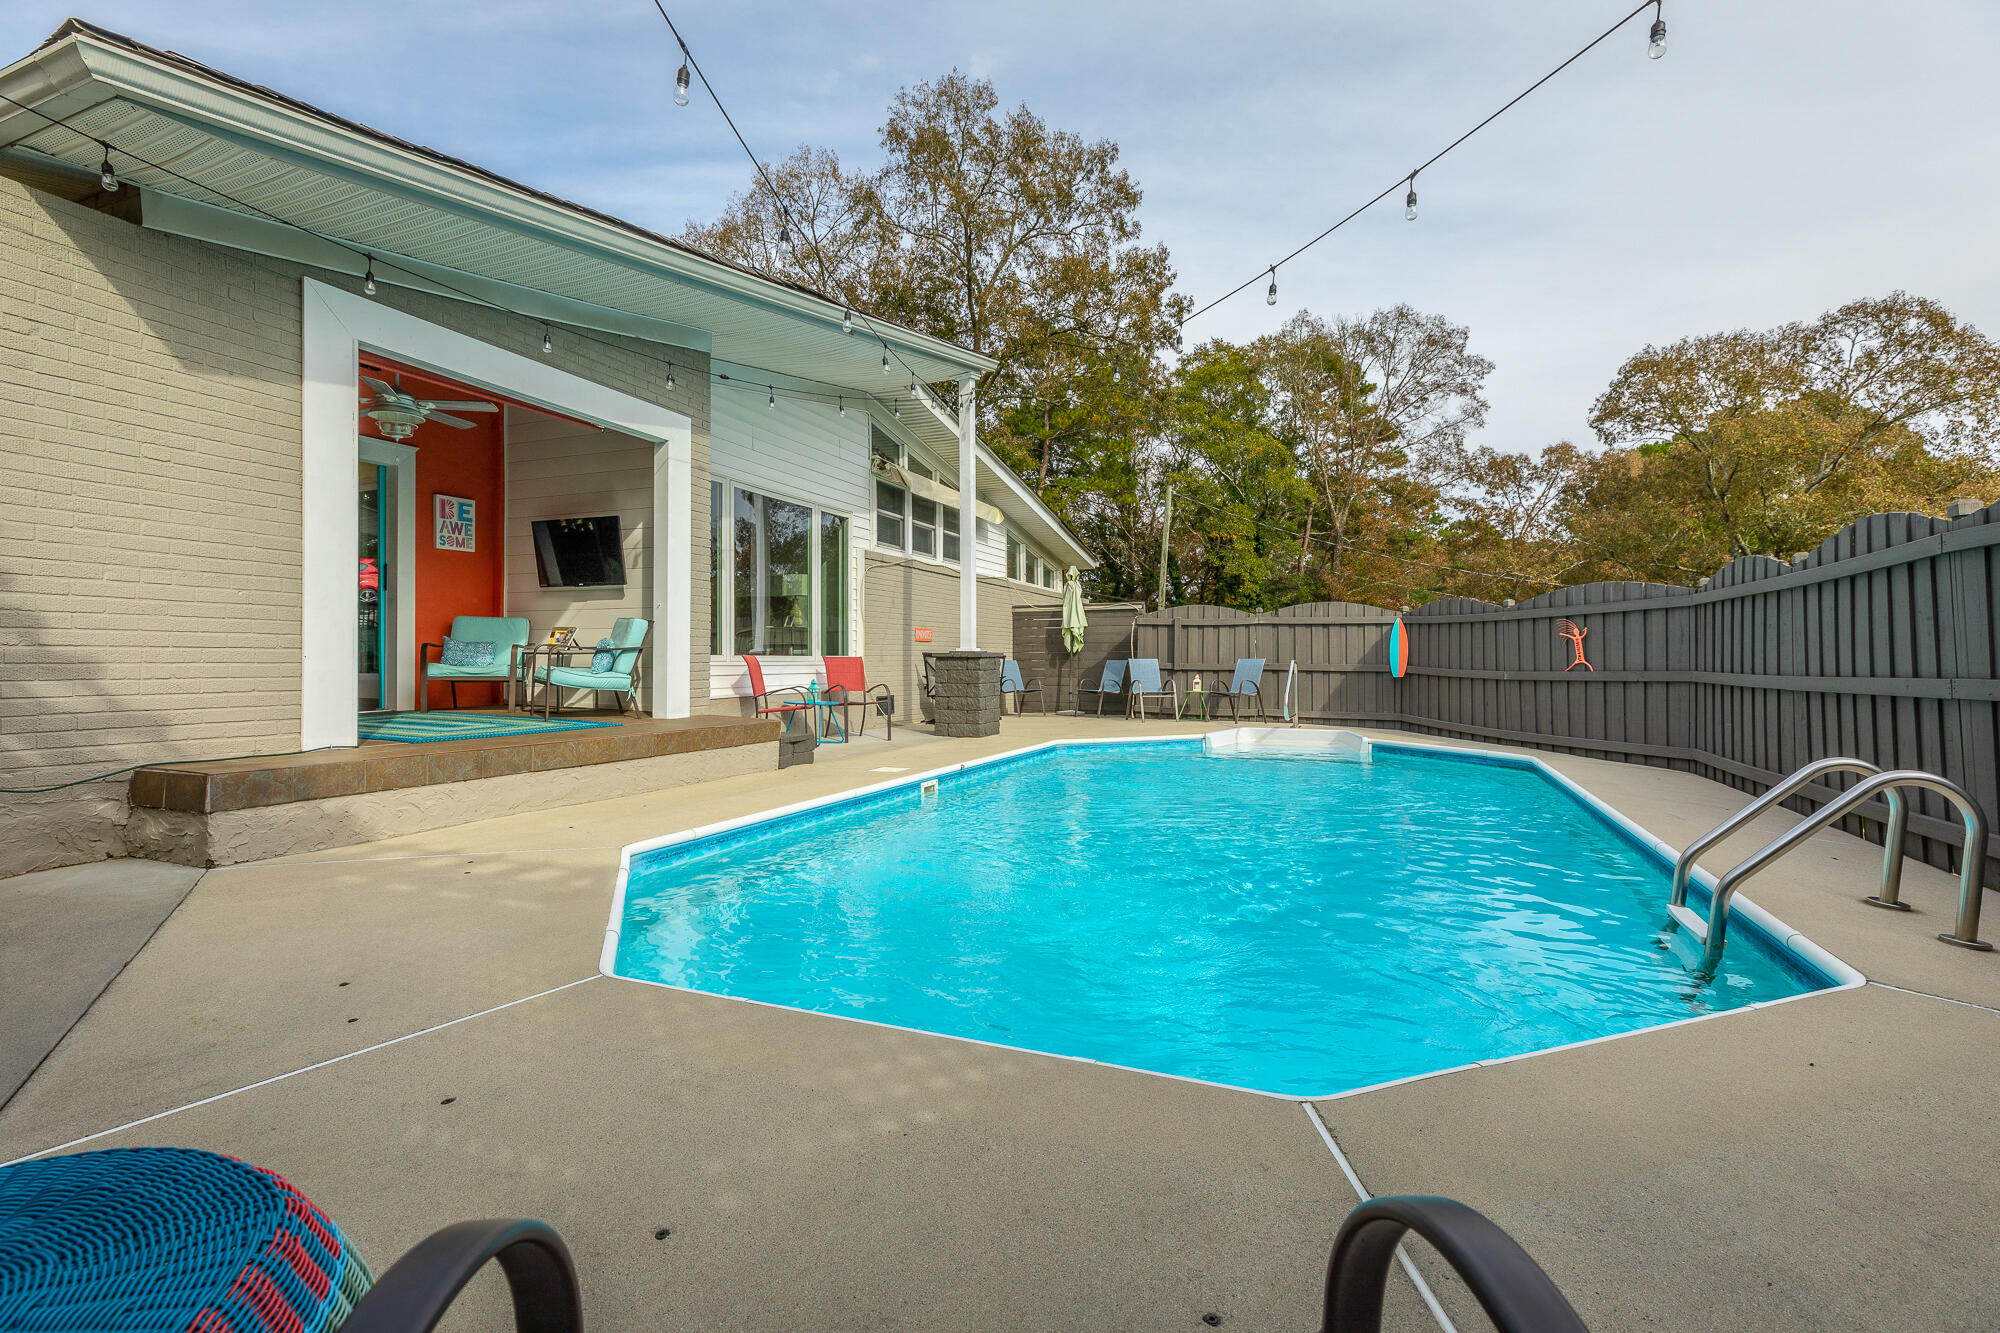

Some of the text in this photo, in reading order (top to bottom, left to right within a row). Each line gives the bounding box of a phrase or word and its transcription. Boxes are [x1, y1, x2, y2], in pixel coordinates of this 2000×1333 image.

[440, 499, 472, 522] BE
[440, 520, 472, 536] AWE
[440, 535, 472, 549] SOME
